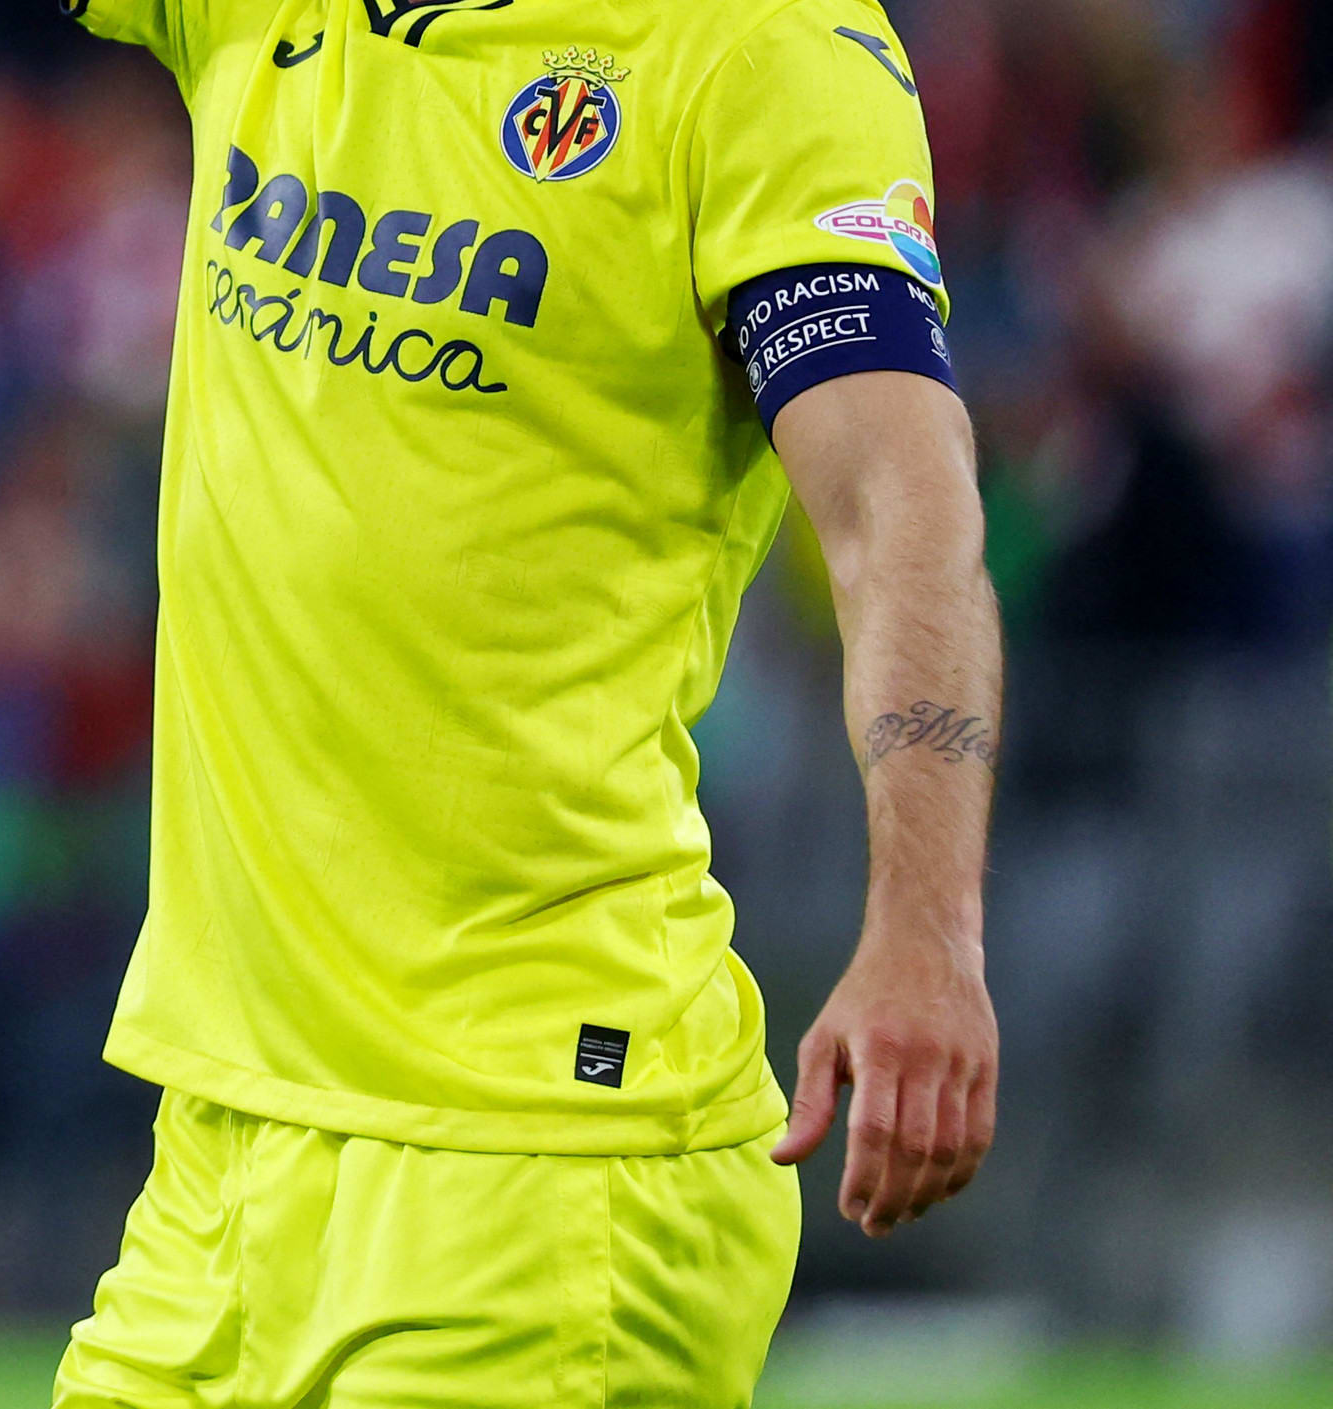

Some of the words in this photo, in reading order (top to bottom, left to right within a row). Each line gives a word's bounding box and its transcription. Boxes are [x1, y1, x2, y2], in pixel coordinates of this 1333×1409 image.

[746, 300, 772, 332] TO
[775, 272, 880, 311] RACISM
[906, 281, 935, 311] NO
[763, 312, 871, 370] RESPECT
